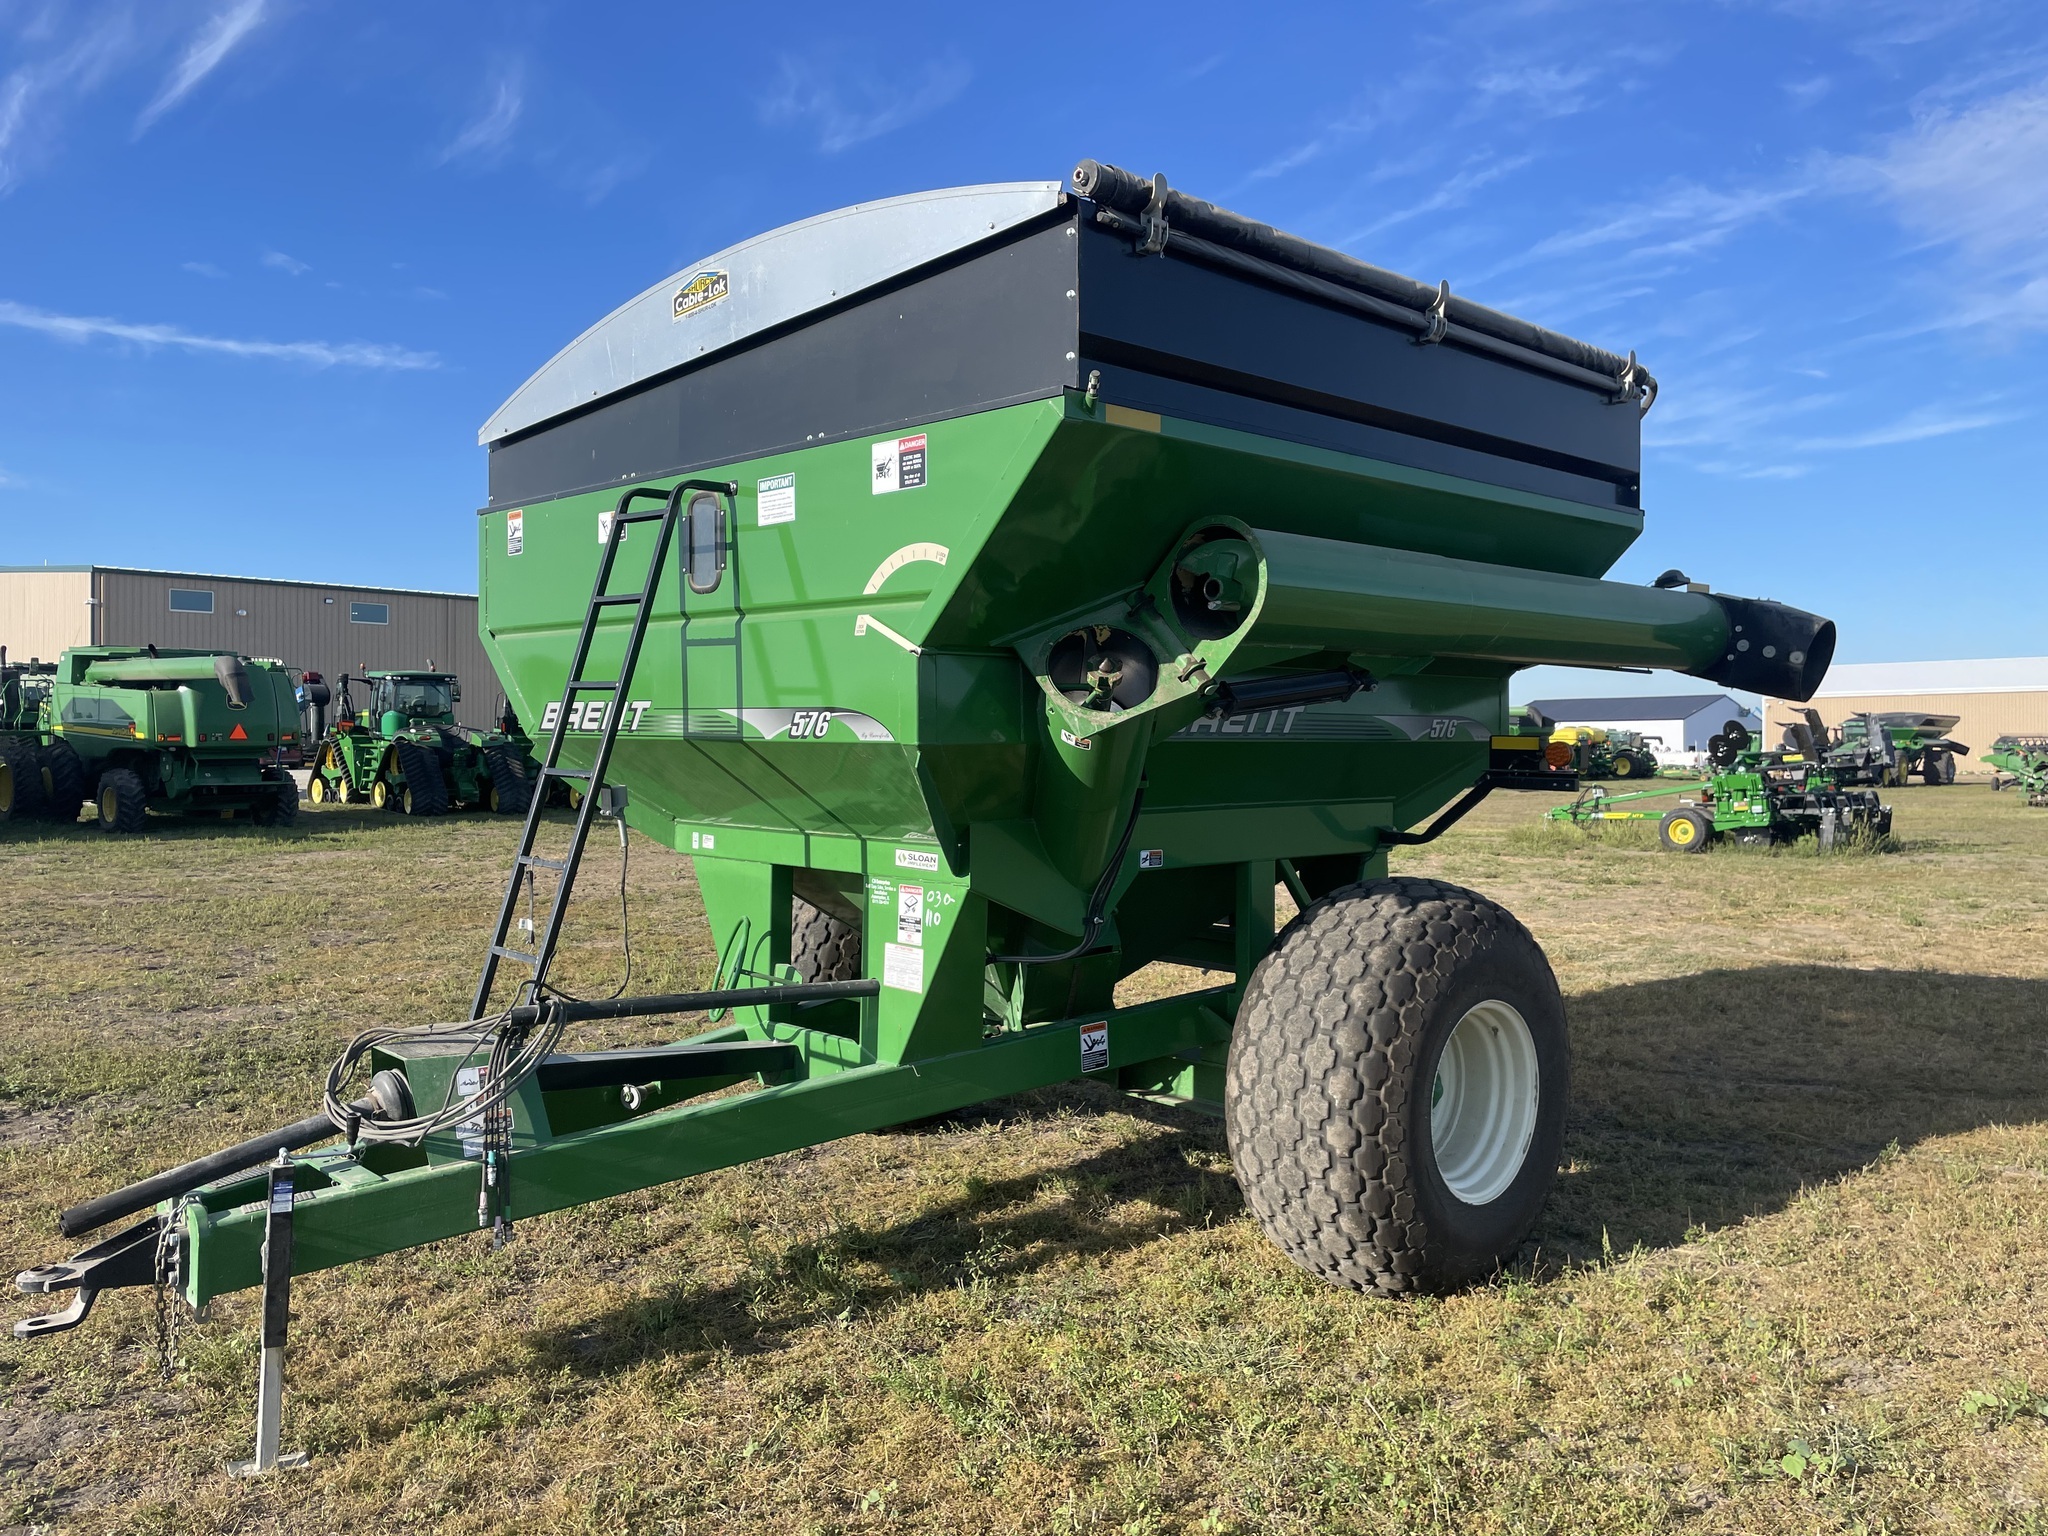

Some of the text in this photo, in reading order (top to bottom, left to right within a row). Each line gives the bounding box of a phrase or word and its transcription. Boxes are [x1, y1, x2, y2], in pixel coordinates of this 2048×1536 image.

[760, 475, 793, 492] IMPORTANT
[789, 711, 831, 738] 576
[1430, 719, 1458, 738] 576
[908, 853, 937, 864] SLOAN
